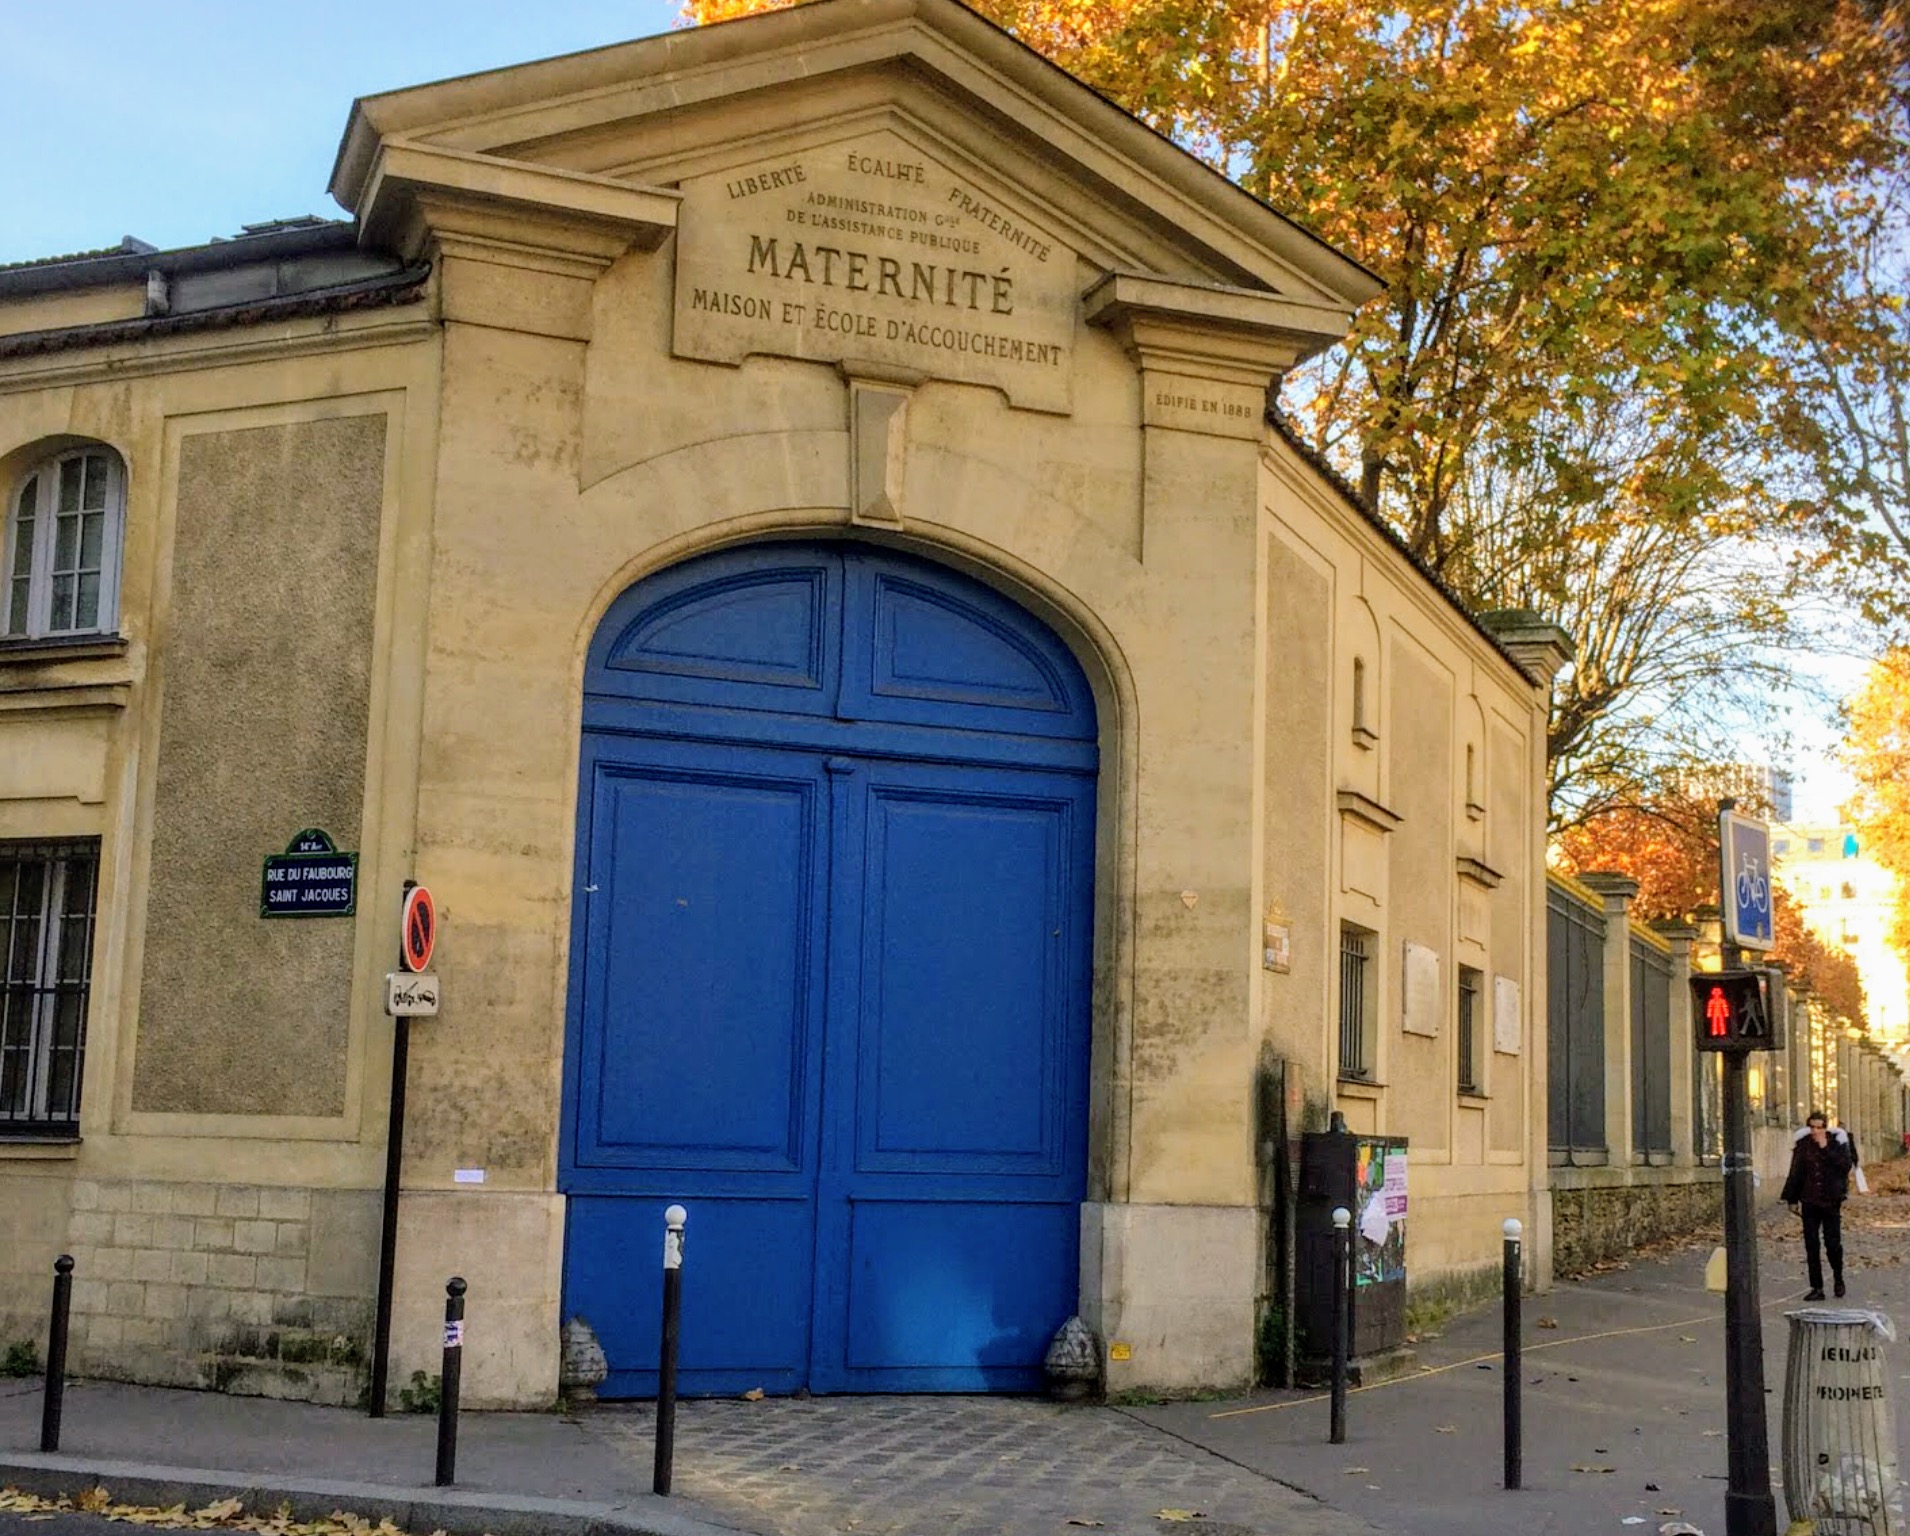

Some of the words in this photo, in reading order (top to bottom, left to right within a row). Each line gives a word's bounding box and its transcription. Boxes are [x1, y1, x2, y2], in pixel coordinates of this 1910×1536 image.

[726, 162, 807, 200] LIBERTÉ
[807, 192, 928, 225] ADMINISTRATION
[947, 187, 1052, 263] FRATERNITÉ
[786, 209, 806, 224] DE
[811, 212, 904, 241] L'ASSISTANCE
[909, 231, 981, 255] PUBLIQUE
[747, 234, 1015, 316] MATERNITÉ
[691, 288, 772, 321] MAISON
[782, 302, 806, 324] ET
[815, 302, 878, 338] ÉCOLE
[886, 320, 1062, 367] D'ACCOUCHEMENT
[1202, 400, 1218, 414] EN
[267, 868, 285, 881] RUE
[287, 867, 300, 881] DU
[303, 866, 353, 880] FAUBOURG
[269, 889, 298, 902] SAINT
[301, 888, 348, 902] JACQUES
